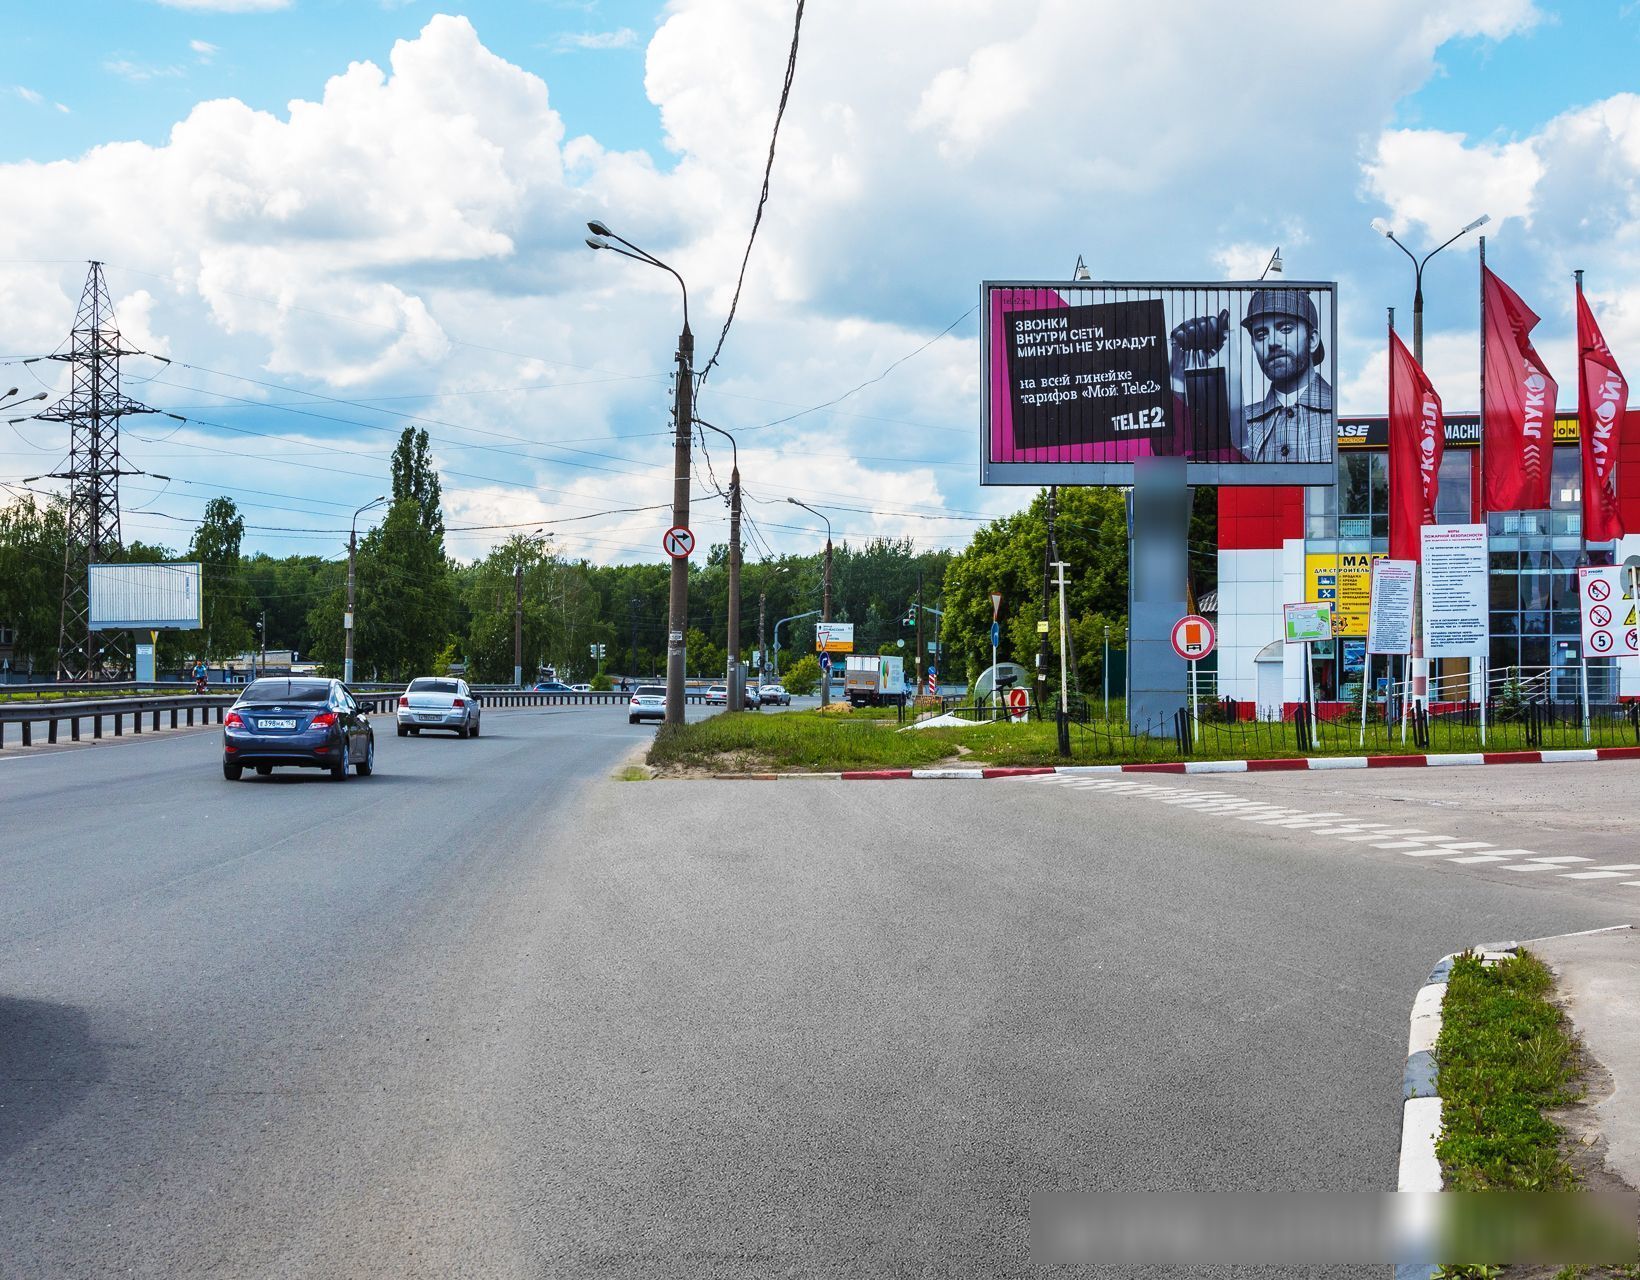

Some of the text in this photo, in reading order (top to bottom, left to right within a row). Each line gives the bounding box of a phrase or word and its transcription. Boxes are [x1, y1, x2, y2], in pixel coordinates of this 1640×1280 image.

[1015, 317, 1068, 332] ЗВОНКИ
[1016, 327, 1104, 345] ВНУТРИ СЕТИ
[1017, 336, 1157, 358] МИНУТЫ НЕ УКРАДУТ
[1020, 370, 1132, 389] на всей линейке
[1021, 380, 1161, 406] тарифов «Мой Tele2»
[1111, 406, 1166, 431] TELE2
[1443, 424, 1480, 439] MACHI
[1598, 635, 1606, 647] 5
